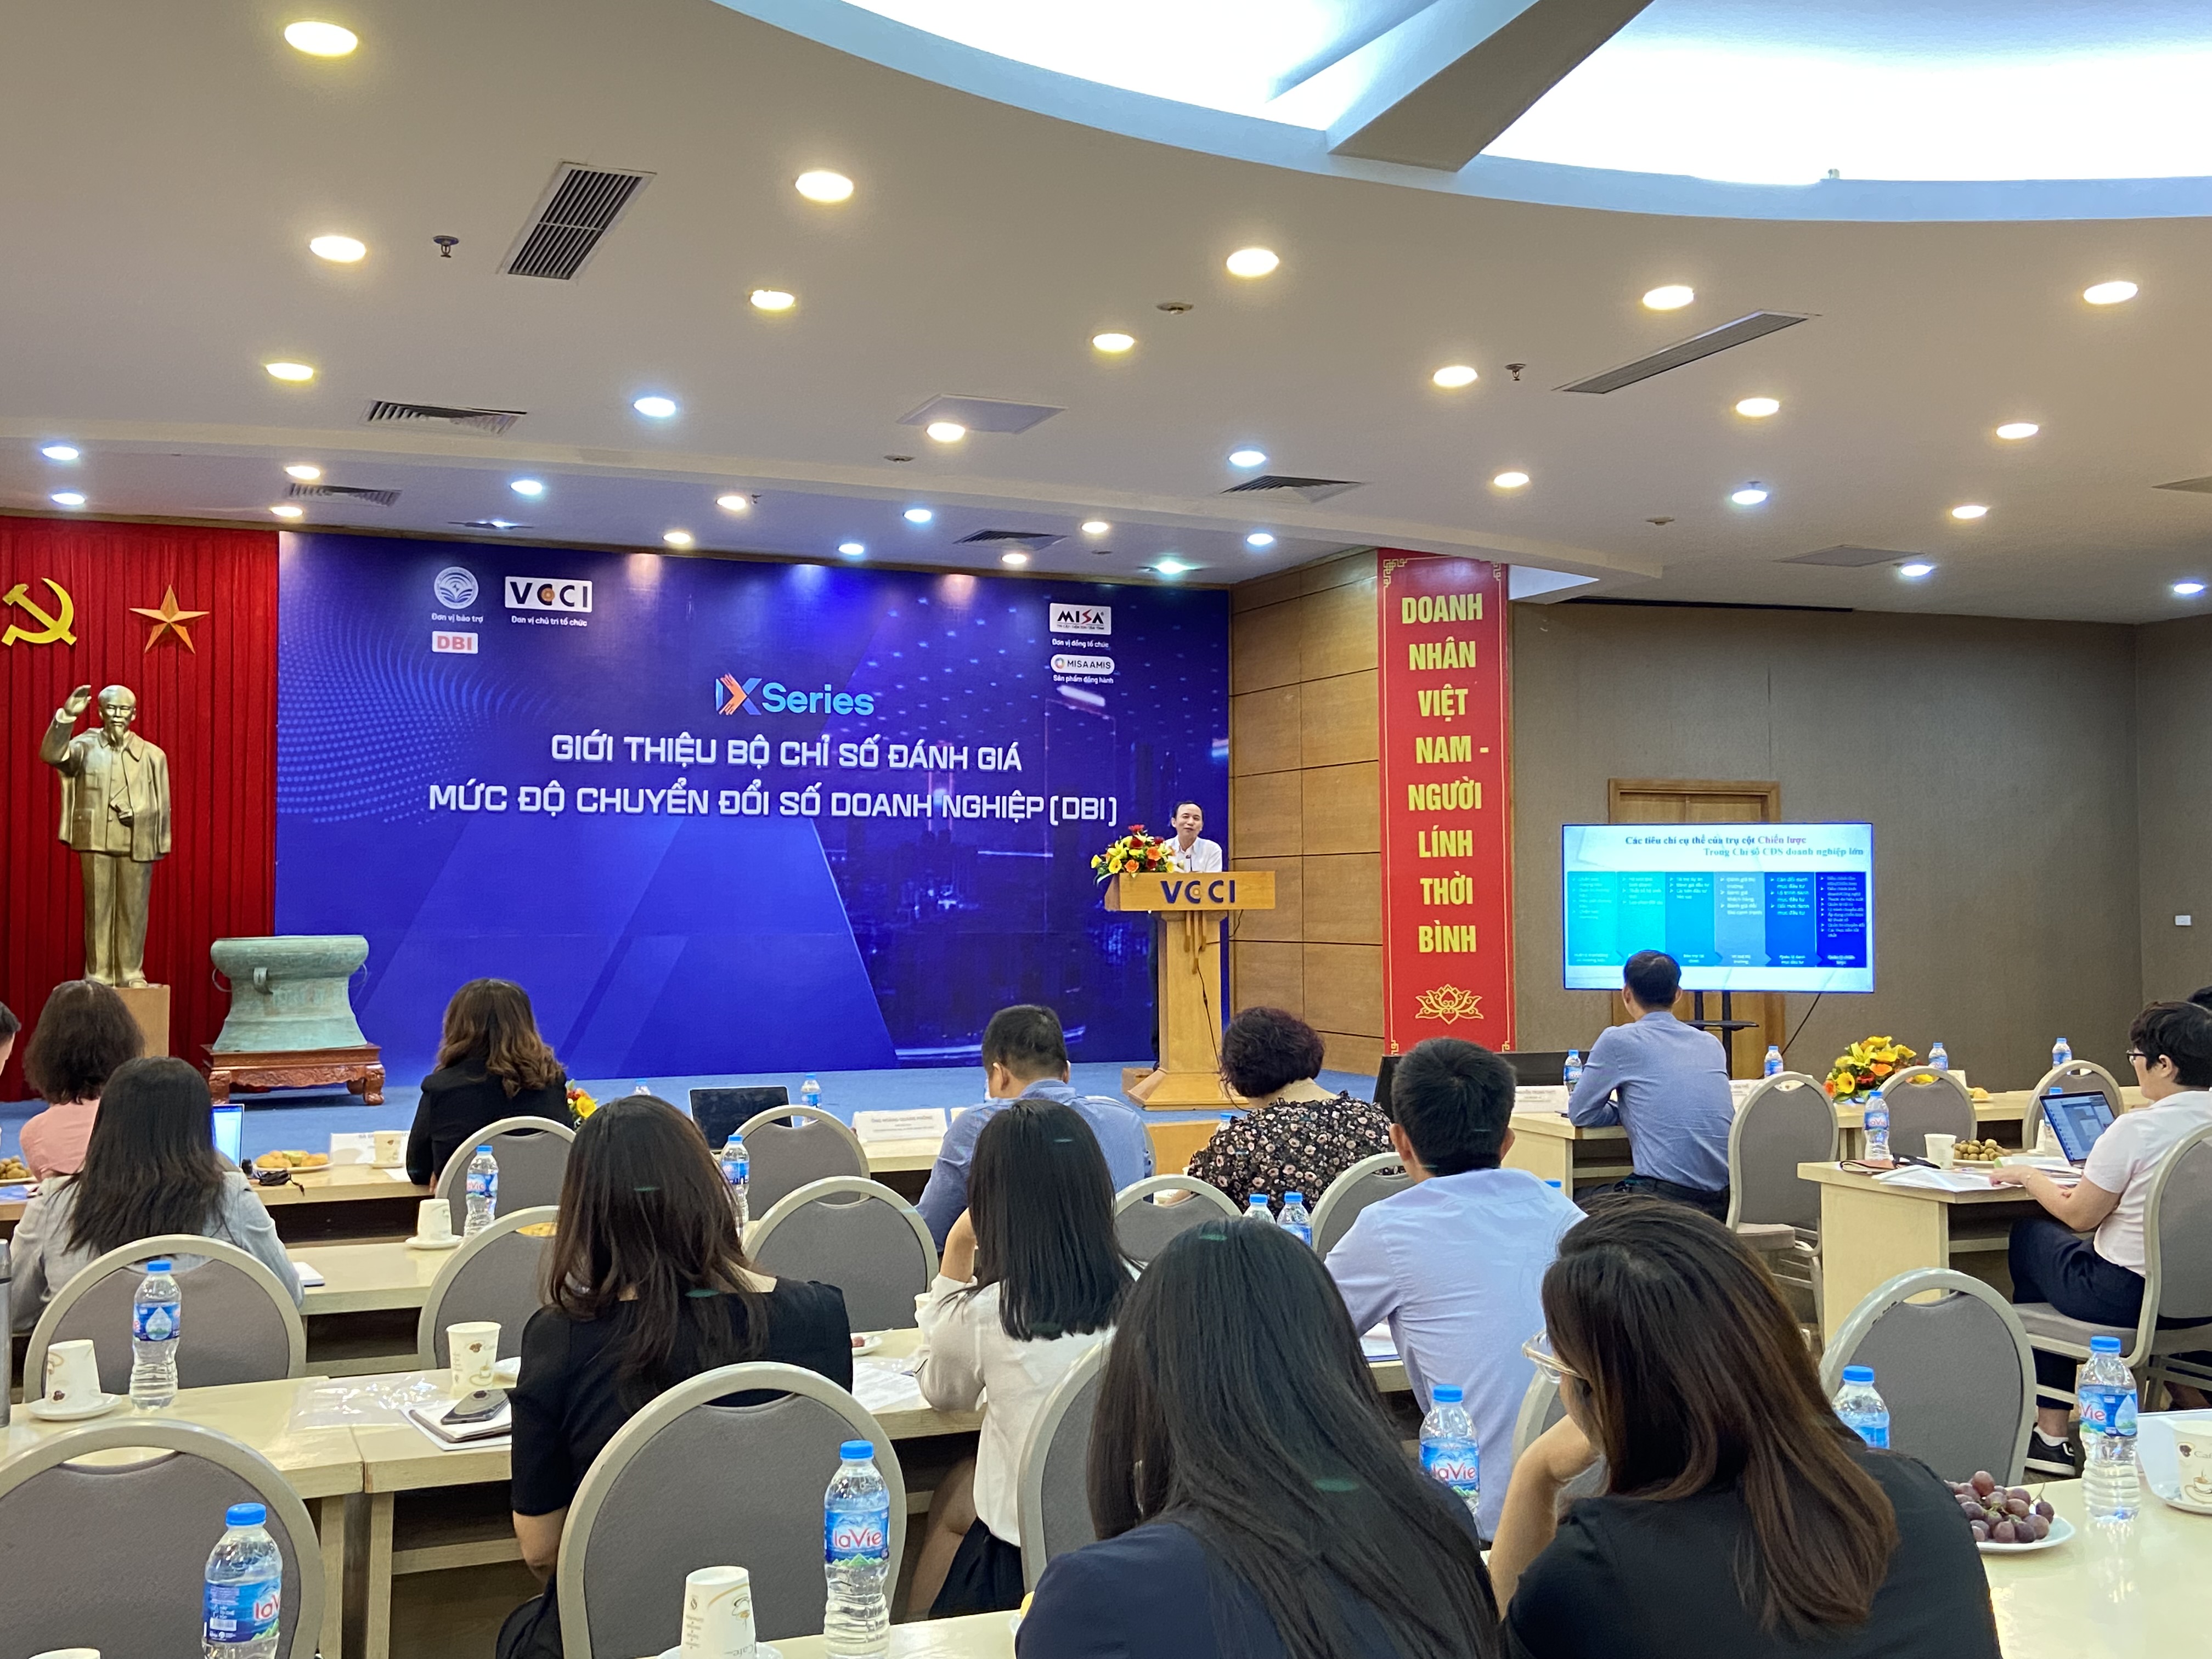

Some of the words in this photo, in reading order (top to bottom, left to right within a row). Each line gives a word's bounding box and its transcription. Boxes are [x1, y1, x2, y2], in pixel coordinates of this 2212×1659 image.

[510, 582, 588, 608] VCCI
[1402, 593, 1483, 624] DOANH
[1057, 609, 1104, 624] MISA
[437, 636, 472, 650] DBI
[1409, 636, 1476, 670] NHÂN
[1418, 684, 1469, 722] VIỆT
[551, 729, 613, 762] GIỚI
[623, 731, 716, 768] THIỆU
[728, 733, 769, 769] BỘ
[780, 734, 829, 766] CHỈ
[839, 734, 881, 768] SỐ
[888, 738, 968, 770] ĐÁNH
[977, 741, 1022, 771] GIÁ
[1415, 735, 1472, 764] NAM
[429, 778, 507, 812] MỨC
[518, 780, 565, 817] ĐỘ
[576, 777, 709, 815] CHUYỂN
[718, 778, 769, 816] ĐỔI
[779, 782, 822, 816] SỐ
[831, 793, 933, 817] DOANH
[942, 789, 1044, 822] NGHIỆP
[1408, 776, 1482, 811] NGƯỜI
[1418, 825, 1474, 858] LÍNH
[1160, 879, 1235, 904] VCCI
[1420, 871, 1474, 905] THỜI
[1418, 919, 1477, 953] BÌNH
[834, 1527, 882, 1548] laVie
